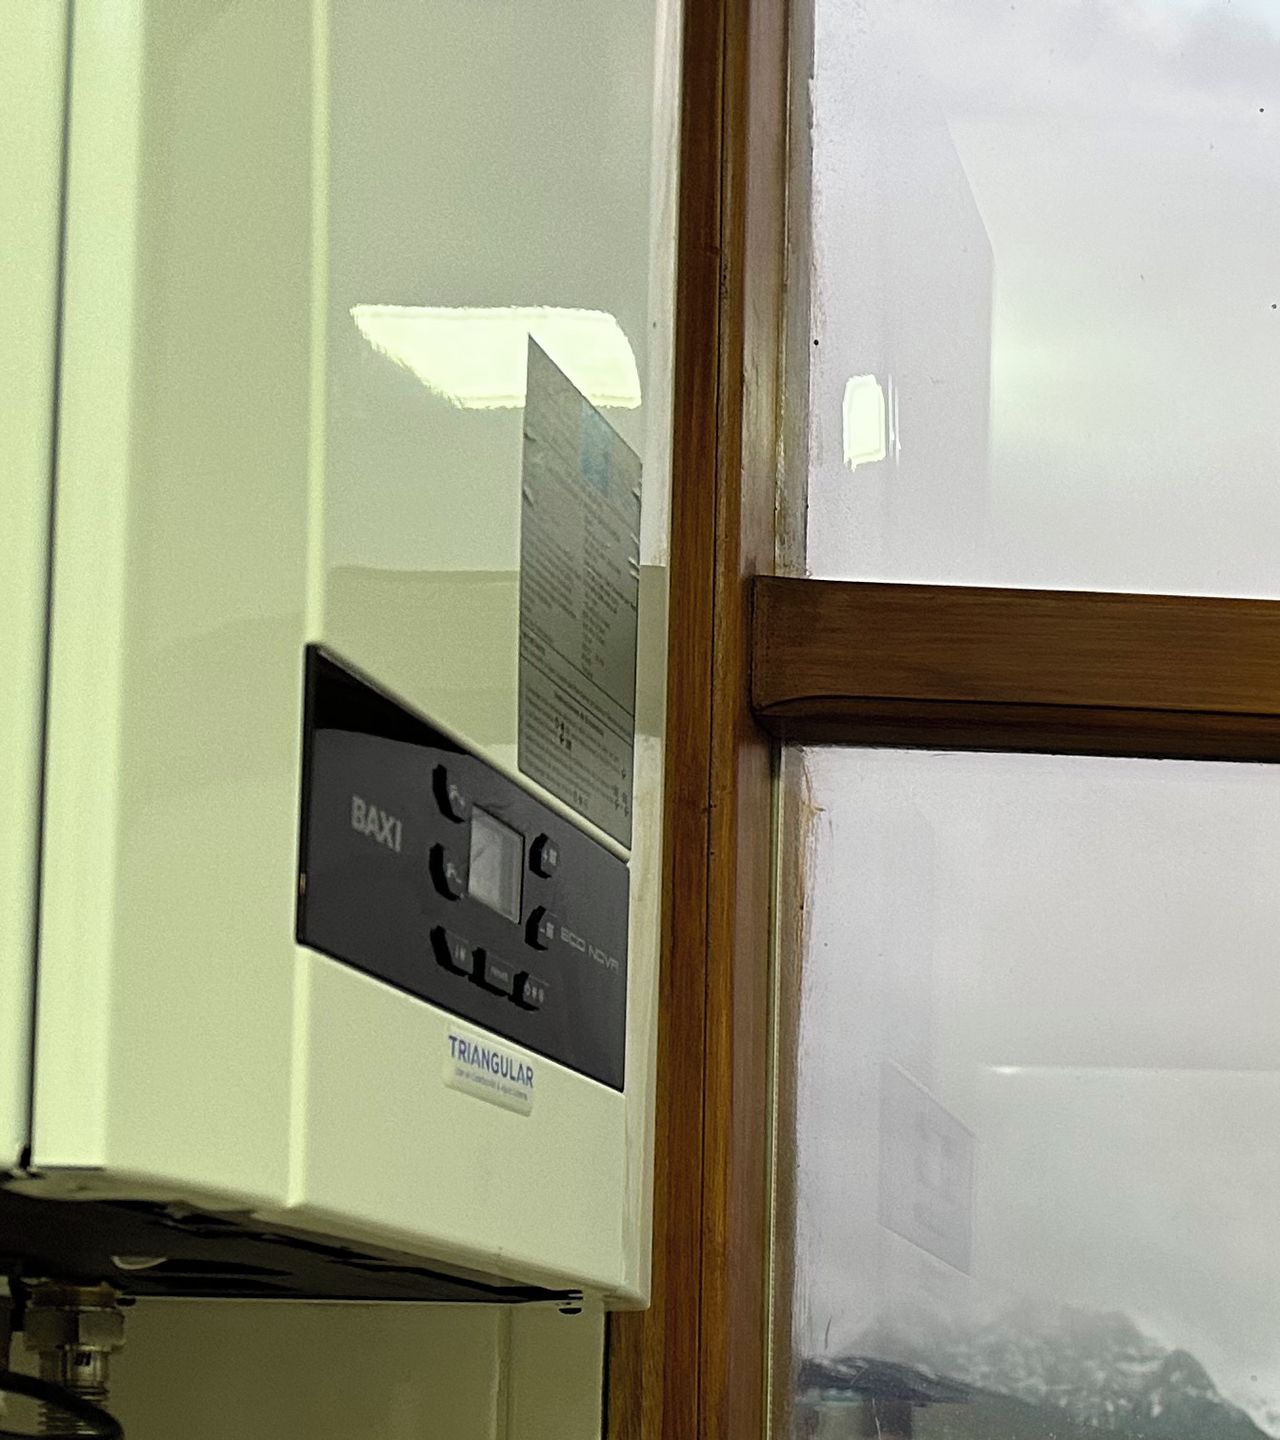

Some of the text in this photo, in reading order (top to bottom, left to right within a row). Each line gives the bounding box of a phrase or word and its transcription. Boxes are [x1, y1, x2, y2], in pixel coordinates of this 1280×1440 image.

[352, 796, 402, 852] BAXI
[560, 926, 586, 953] ECO
[448, 1034, 534, 1089] TRIANGULAR
